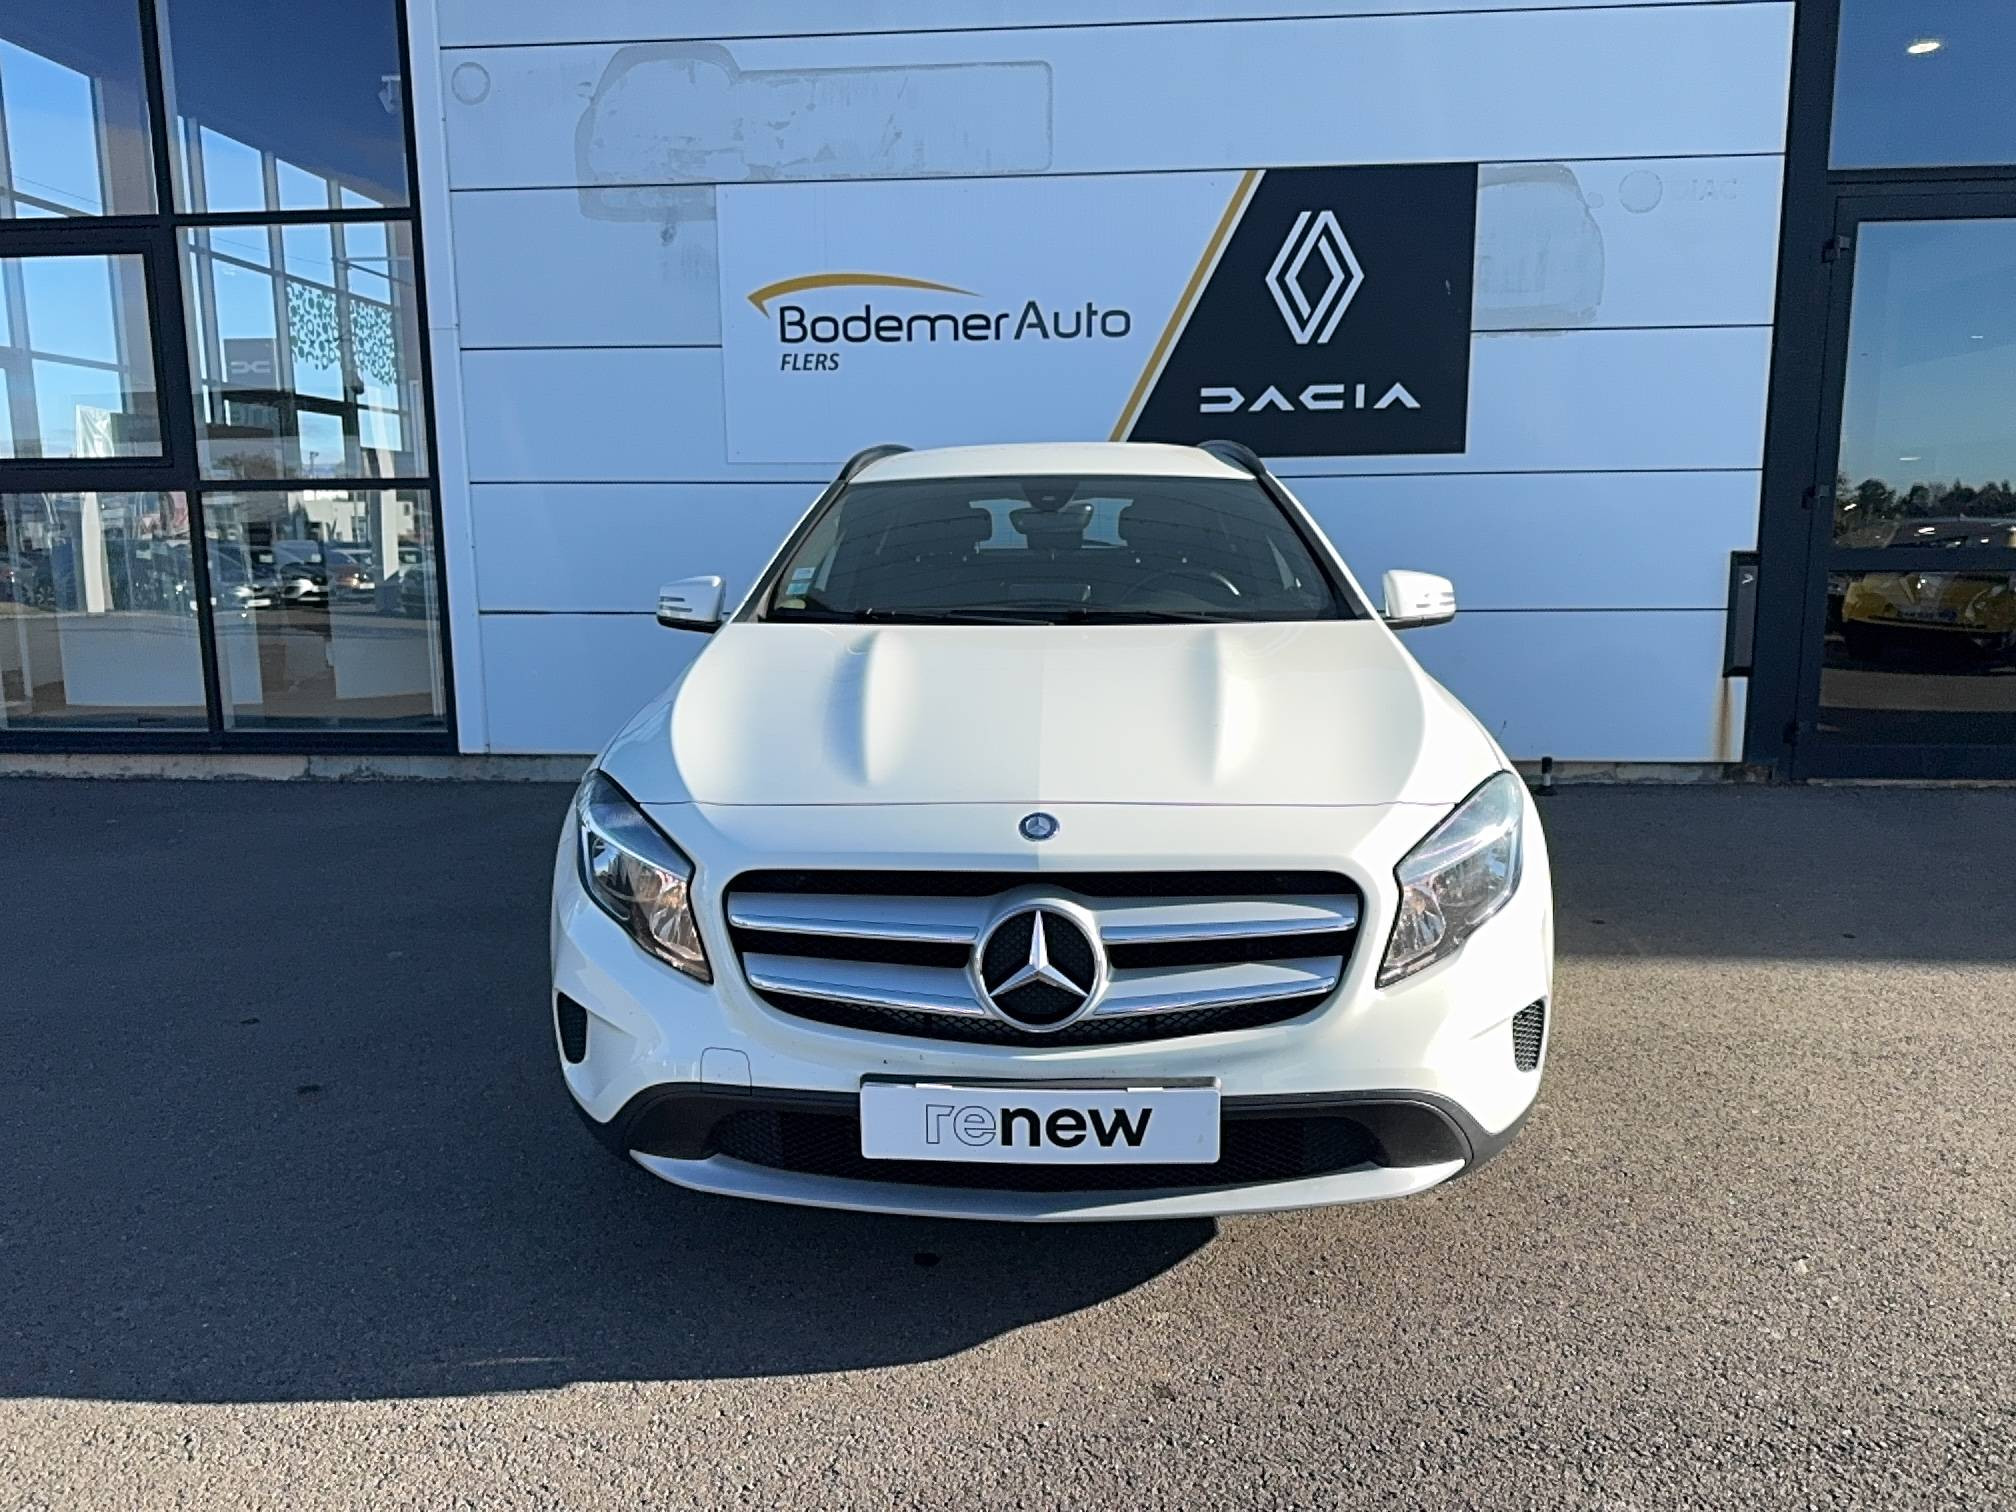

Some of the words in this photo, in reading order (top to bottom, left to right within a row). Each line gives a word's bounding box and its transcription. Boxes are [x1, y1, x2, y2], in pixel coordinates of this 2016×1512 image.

[780, 352, 840, 371] FLERS
[1200, 382, 1421, 413] DACIA
[925, 1103, 1153, 1148] renew
